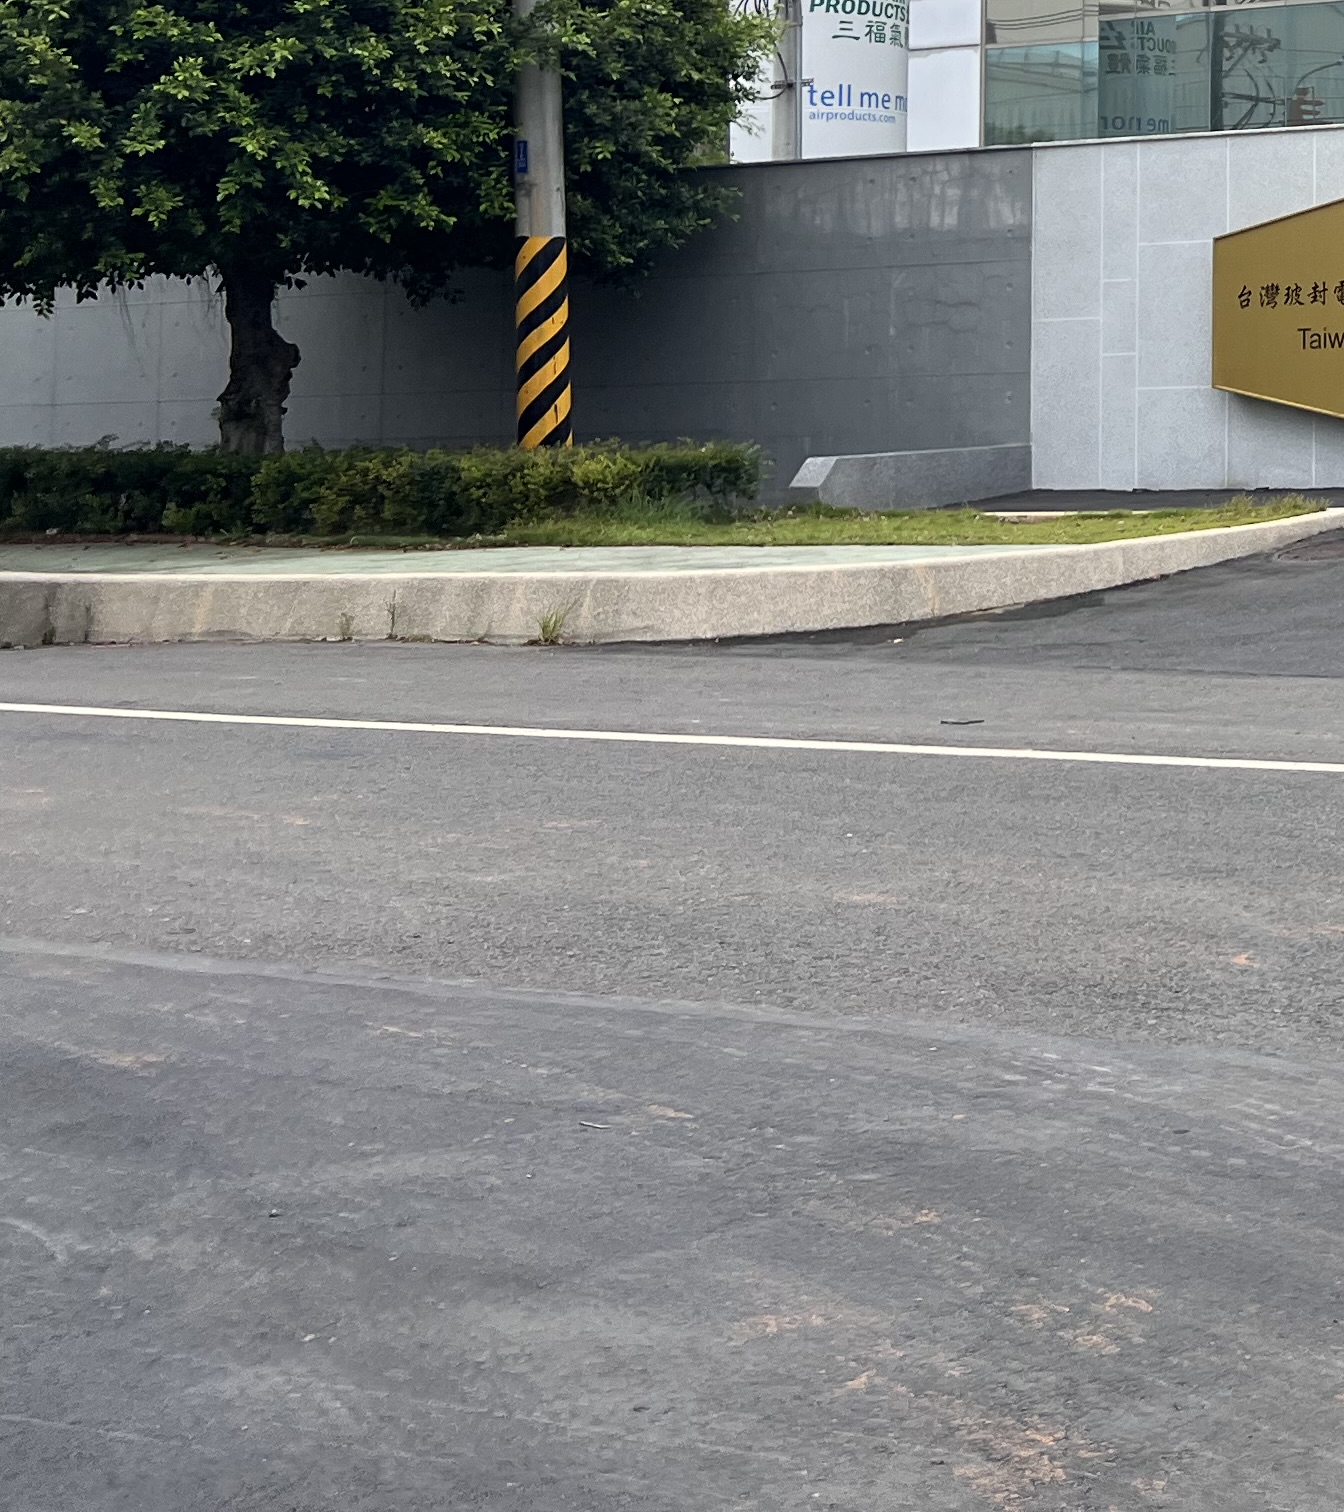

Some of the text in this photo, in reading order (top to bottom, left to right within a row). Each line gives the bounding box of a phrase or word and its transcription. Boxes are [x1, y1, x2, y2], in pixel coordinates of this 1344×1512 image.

[832, 20, 909, 48] 三福氣
[807, 84, 852, 107] tell
[860, 91, 891, 110] me
[809, 109, 896, 123] airproducts.com
